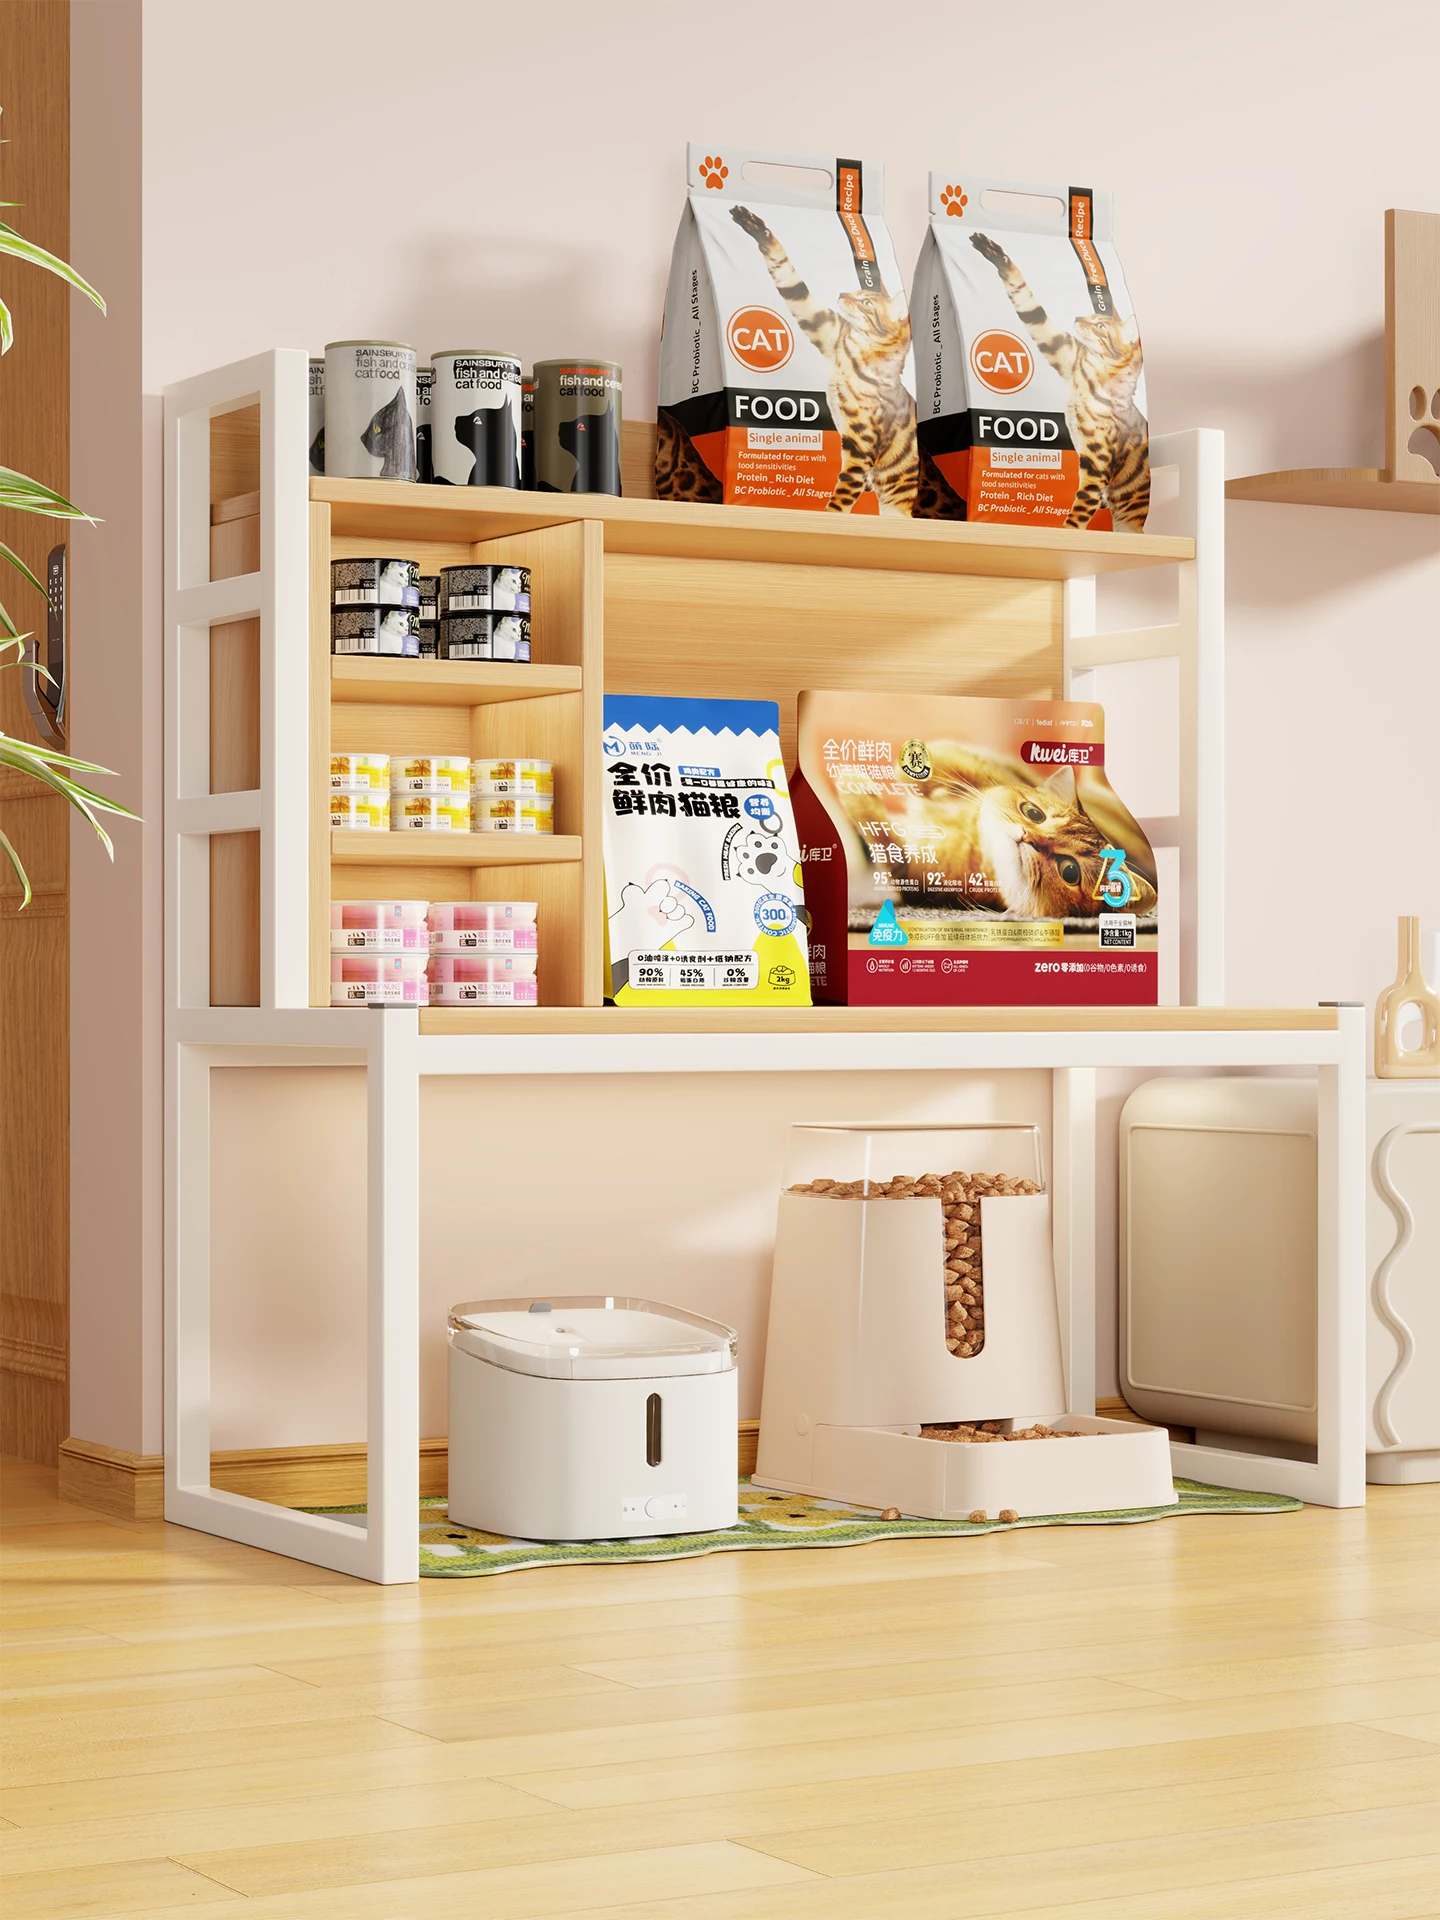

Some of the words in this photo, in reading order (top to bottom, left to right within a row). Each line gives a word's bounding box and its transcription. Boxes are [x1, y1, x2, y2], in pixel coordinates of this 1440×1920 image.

[844, 174, 854, 211] Recipe
[845, 212, 860, 235] Duck
[1076, 201, 1085, 237] Recipe
[857, 237, 867, 258] Free
[1077, 238, 1092, 260] Duck
[862, 259, 873, 287] Grain
[1089, 262, 1099, 282] Free
[691, 269, 699, 304] Stages
[1094, 285, 1106, 311] Grain
[733, 328, 786, 351] CAT
[356, 357, 376, 367] fish
[379, 358, 398, 369] and
[975, 351, 1026, 374] CAT
[455, 367, 477, 378] fish
[479, 368, 500, 379] and
[934, 352, 942, 398] Probiotic
[455, 380, 474, 389] cat
[476, 379, 501, 390] food
[559, 375, 580, 386] fish
[582, 376, 603, 387] and
[692, 379, 699, 393] BC
[559, 386, 578, 396] cat
[580, 386, 604, 397] food
[735, 395, 820, 422] FOOD
[933, 400, 941, 414] BC
[978, 415, 1059, 442] FOOD
[749, 432, 782, 445] Single
[785, 433, 821, 443] animal
[738, 451, 781, 460] Formulated
[811, 454, 826, 462] with
[992, 452, 1023, 464] Single
[1026, 452, 1060, 463] animal
[756, 463, 796, 471] sensitivities
[737, 472, 768, 482] Protein
[775, 473, 794, 483] Rich
[796, 475, 814, 485] Diet
[982, 470, 1022, 479] Formulated
[1024, 471, 1034, 479] for
[734, 486, 746, 494] BC
[748, 486, 786, 495] Probiotic
[792, 487, 804, 496] All
[806, 488, 833, 499] Stages
[980, 490, 1009, 500] Protein
[1017, 492, 1034, 501] Rich
[1036, 493, 1053, 502] Diet
[978, 503, 989, 512] BC
[990, 504, 1026, 513] Probiotic
[1032, 505, 1044, 514] All
[1045, 506, 1070, 516] Stages
[822, 738, 892, 762] 全价鲜肉
[607, 761, 672, 787] 全价
[835, 781, 924, 797] COMPLETE
[612, 789, 741, 819] 鲜肉猫粮
[858, 821, 906, 837] HFFG
[868, 842, 939, 864] 猎食养成
[698, 899, 711, 911] CAT
[705, 912, 715, 930] FOOD
[762, 908, 786, 921] 300
[872, 928, 903, 942] 免疫力
[639, 968, 663, 977] 90%
[680, 968, 703, 977] 45%
[727, 968, 745, 977] 0%
[1034, 962, 1060, 973] zero
[776, 976, 790, 984] 2kg
